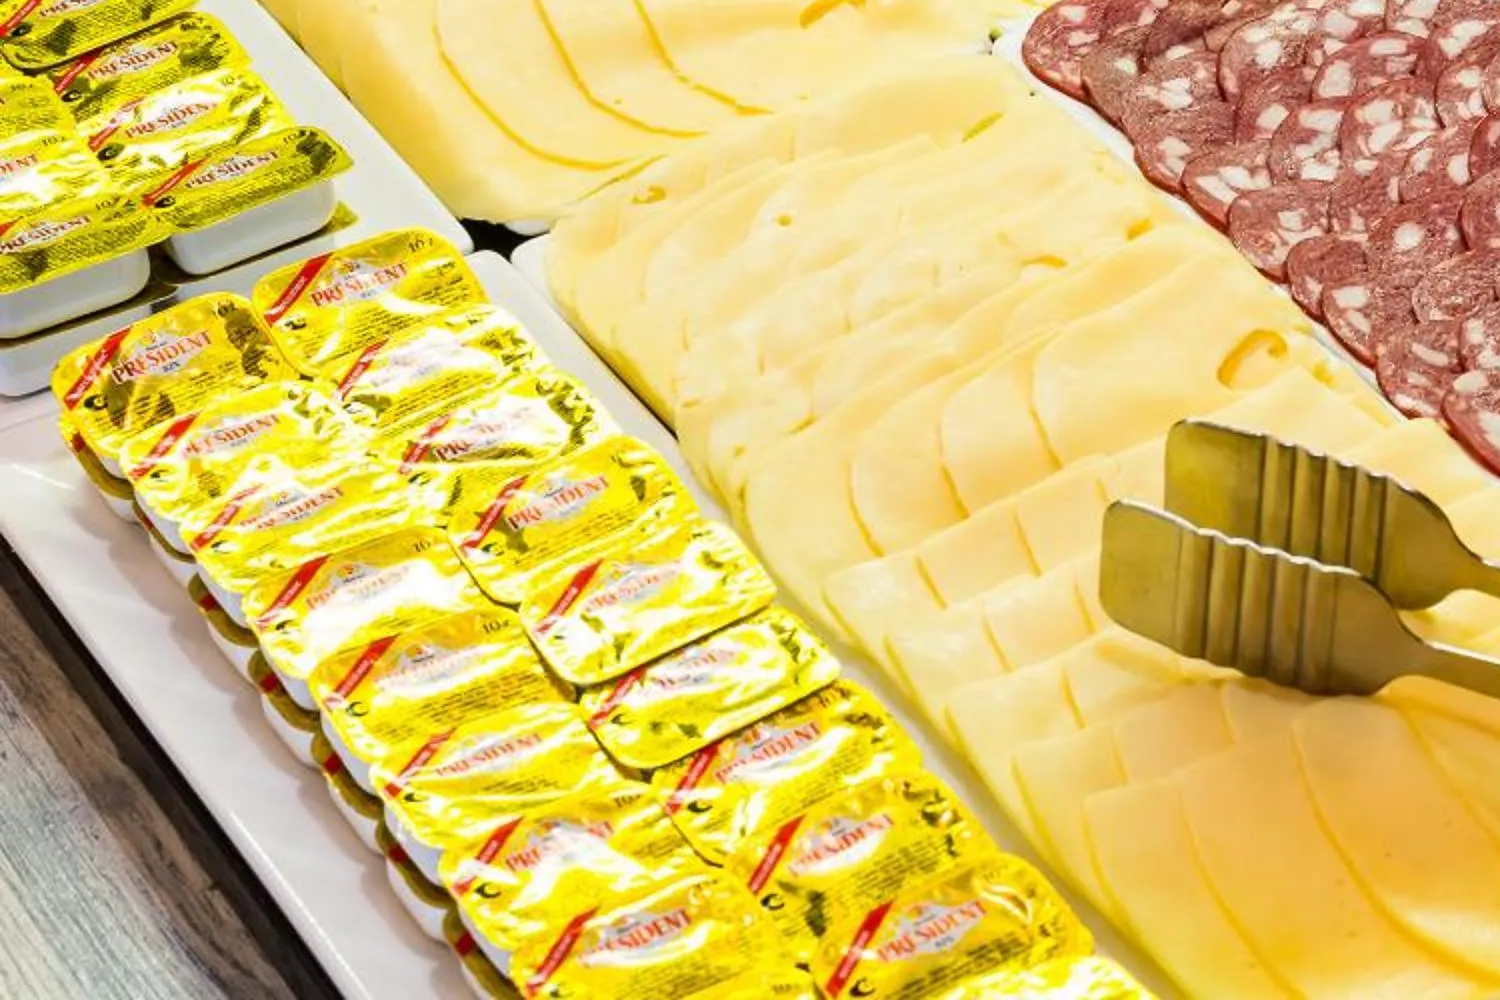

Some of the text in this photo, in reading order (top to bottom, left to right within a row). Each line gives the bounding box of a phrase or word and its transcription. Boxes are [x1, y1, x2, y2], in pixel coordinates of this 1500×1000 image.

[88, 42, 179, 80] PRESIDENT
[185, 150, 280, 189] PRESIDENT
[309, 262, 409, 307] PRESIENT
[112, 329, 212, 384] PRESIDENT
[507, 475, 610, 530] PREIDENT
